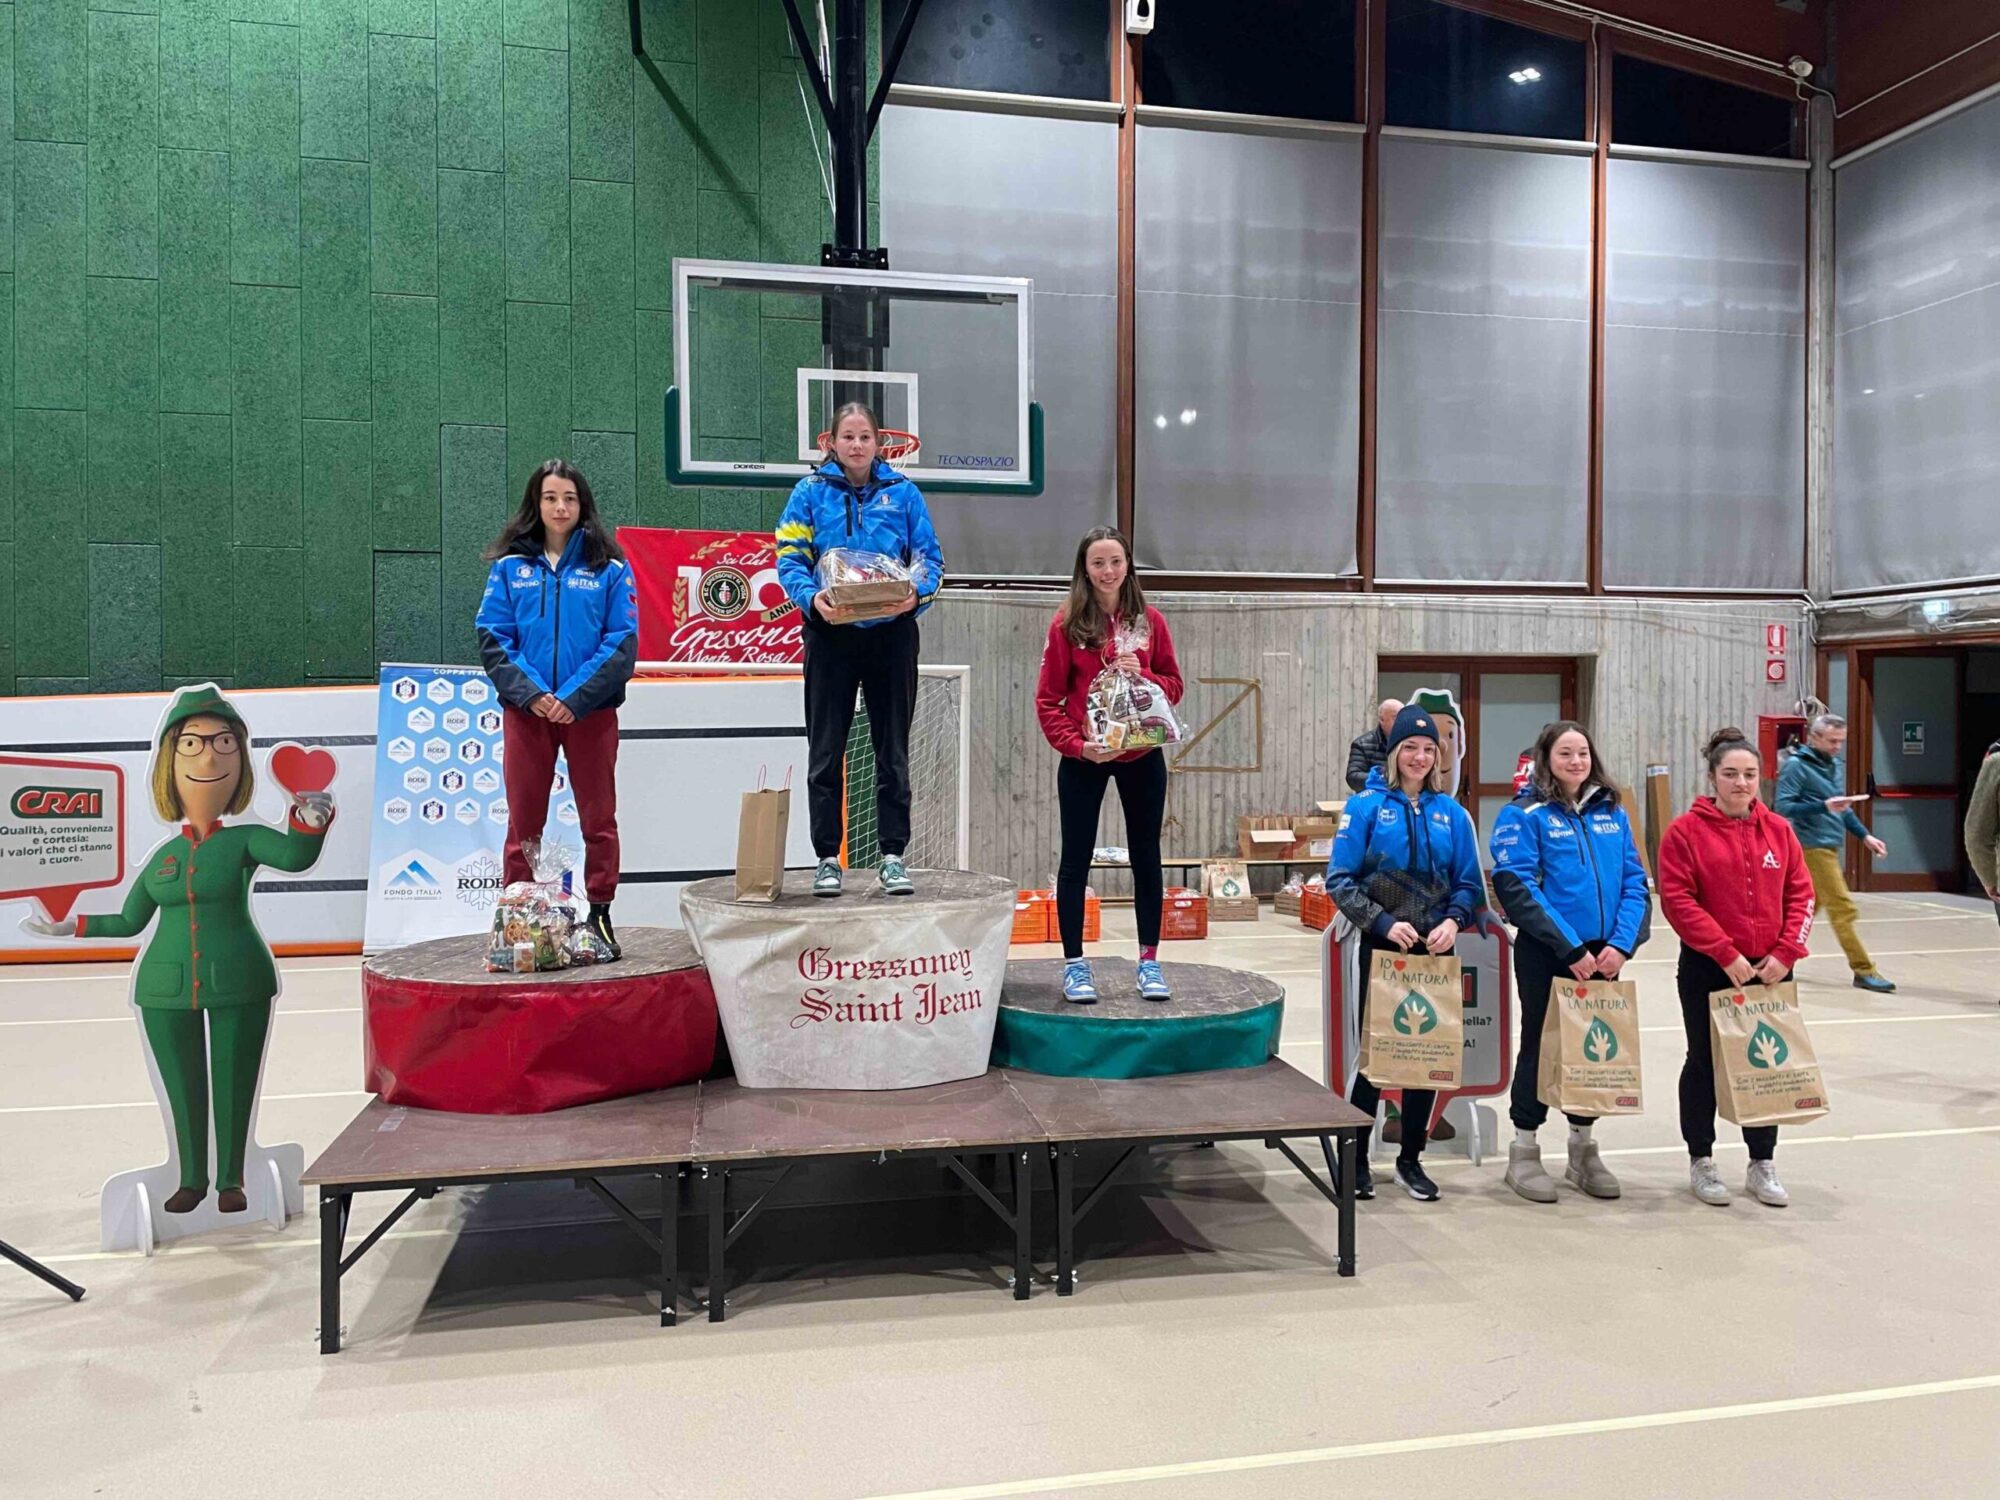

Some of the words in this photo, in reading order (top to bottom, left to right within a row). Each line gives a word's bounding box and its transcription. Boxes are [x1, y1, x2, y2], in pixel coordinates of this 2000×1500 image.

[937, 454, 1014, 467] TECNOSPAZIO
[716, 552, 739, 565] Sci
[17, 790, 99, 814] CRAI
[0, 825, 47, 836] Qualità,
[50, 824, 114, 834] convenienza
[33, 837, 40, 845] e
[43, 835, 89, 844] cortesia:
[8, 846, 43, 857] valori
[46, 845, 66, 855] che
[68, 844, 78, 853] ci
[80, 843, 113, 852] stanno
[39, 857, 46, 865] a
[49, 856, 83, 865] cuore.
[457, 878, 504, 889] RODE
[797, 946, 974, 982] Gressoney
[1379, 957, 1392, 970] IO
[1382, 970, 1397, 981] LA
[1402, 972, 1449, 986] NATURA
[790, 987, 904, 1029] Saint
[912, 982, 982, 1025] Jean
[1568, 1000, 1580, 1009] LA
[1585, 999, 1628, 1010] NATURA
[1718, 996, 1731, 1008] IO
[1725, 1006, 1742, 1018] LA
[1746, 1000, 1790, 1016] NATURA
